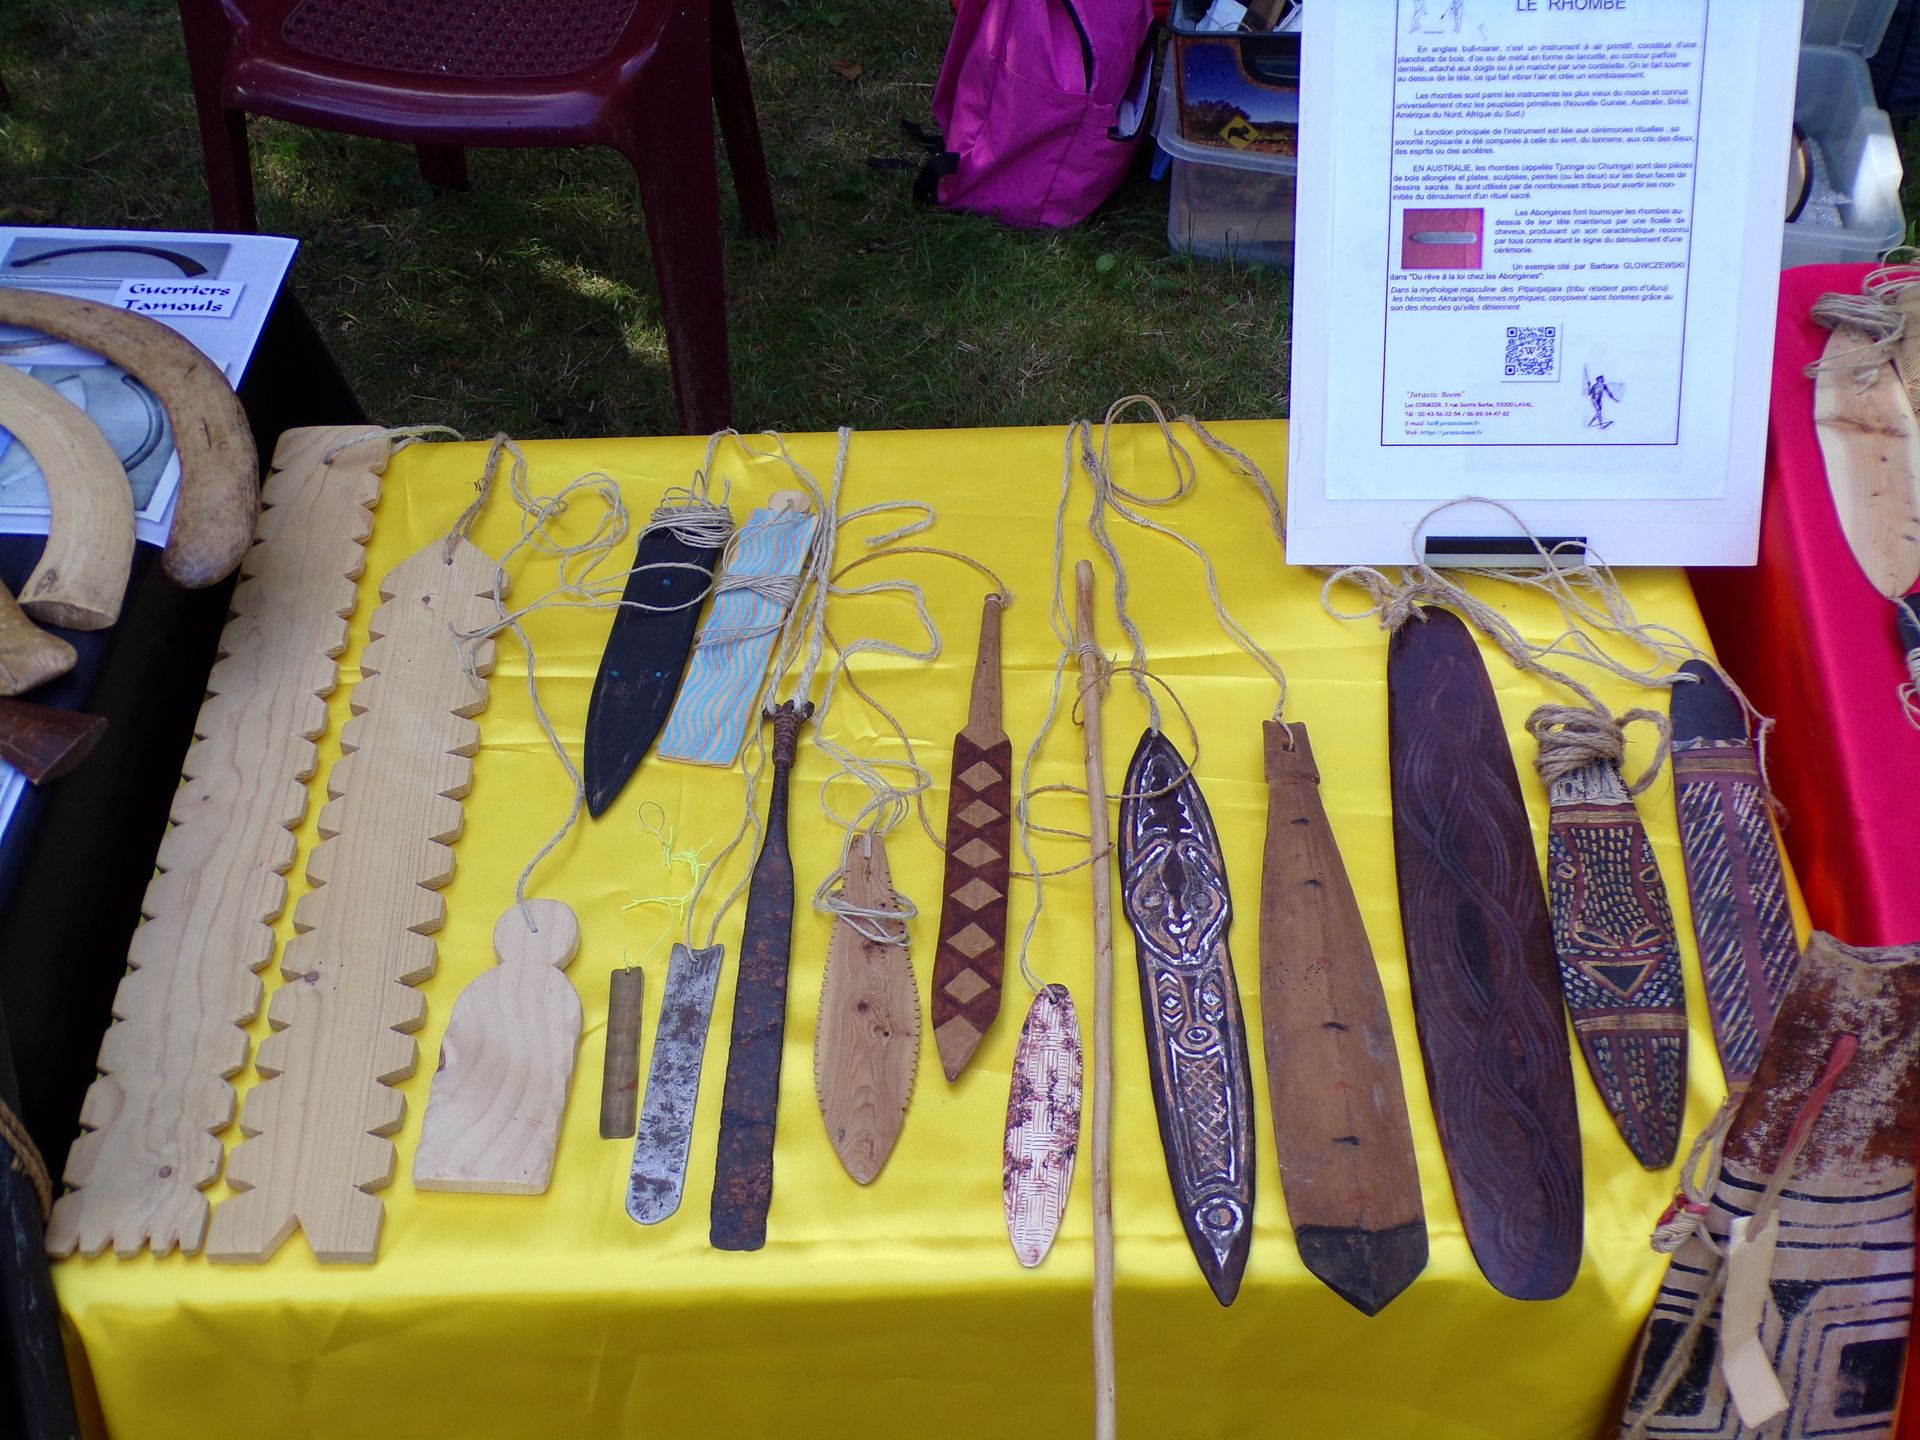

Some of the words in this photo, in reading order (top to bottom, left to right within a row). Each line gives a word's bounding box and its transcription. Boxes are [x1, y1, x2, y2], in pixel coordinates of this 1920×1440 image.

[1516, 0, 1538, 11] LE
[1549, 0, 1626, 10] RHOMBE
[129, 284, 230, 296] Guerriers
[125, 300, 223, 312] Tamouls
